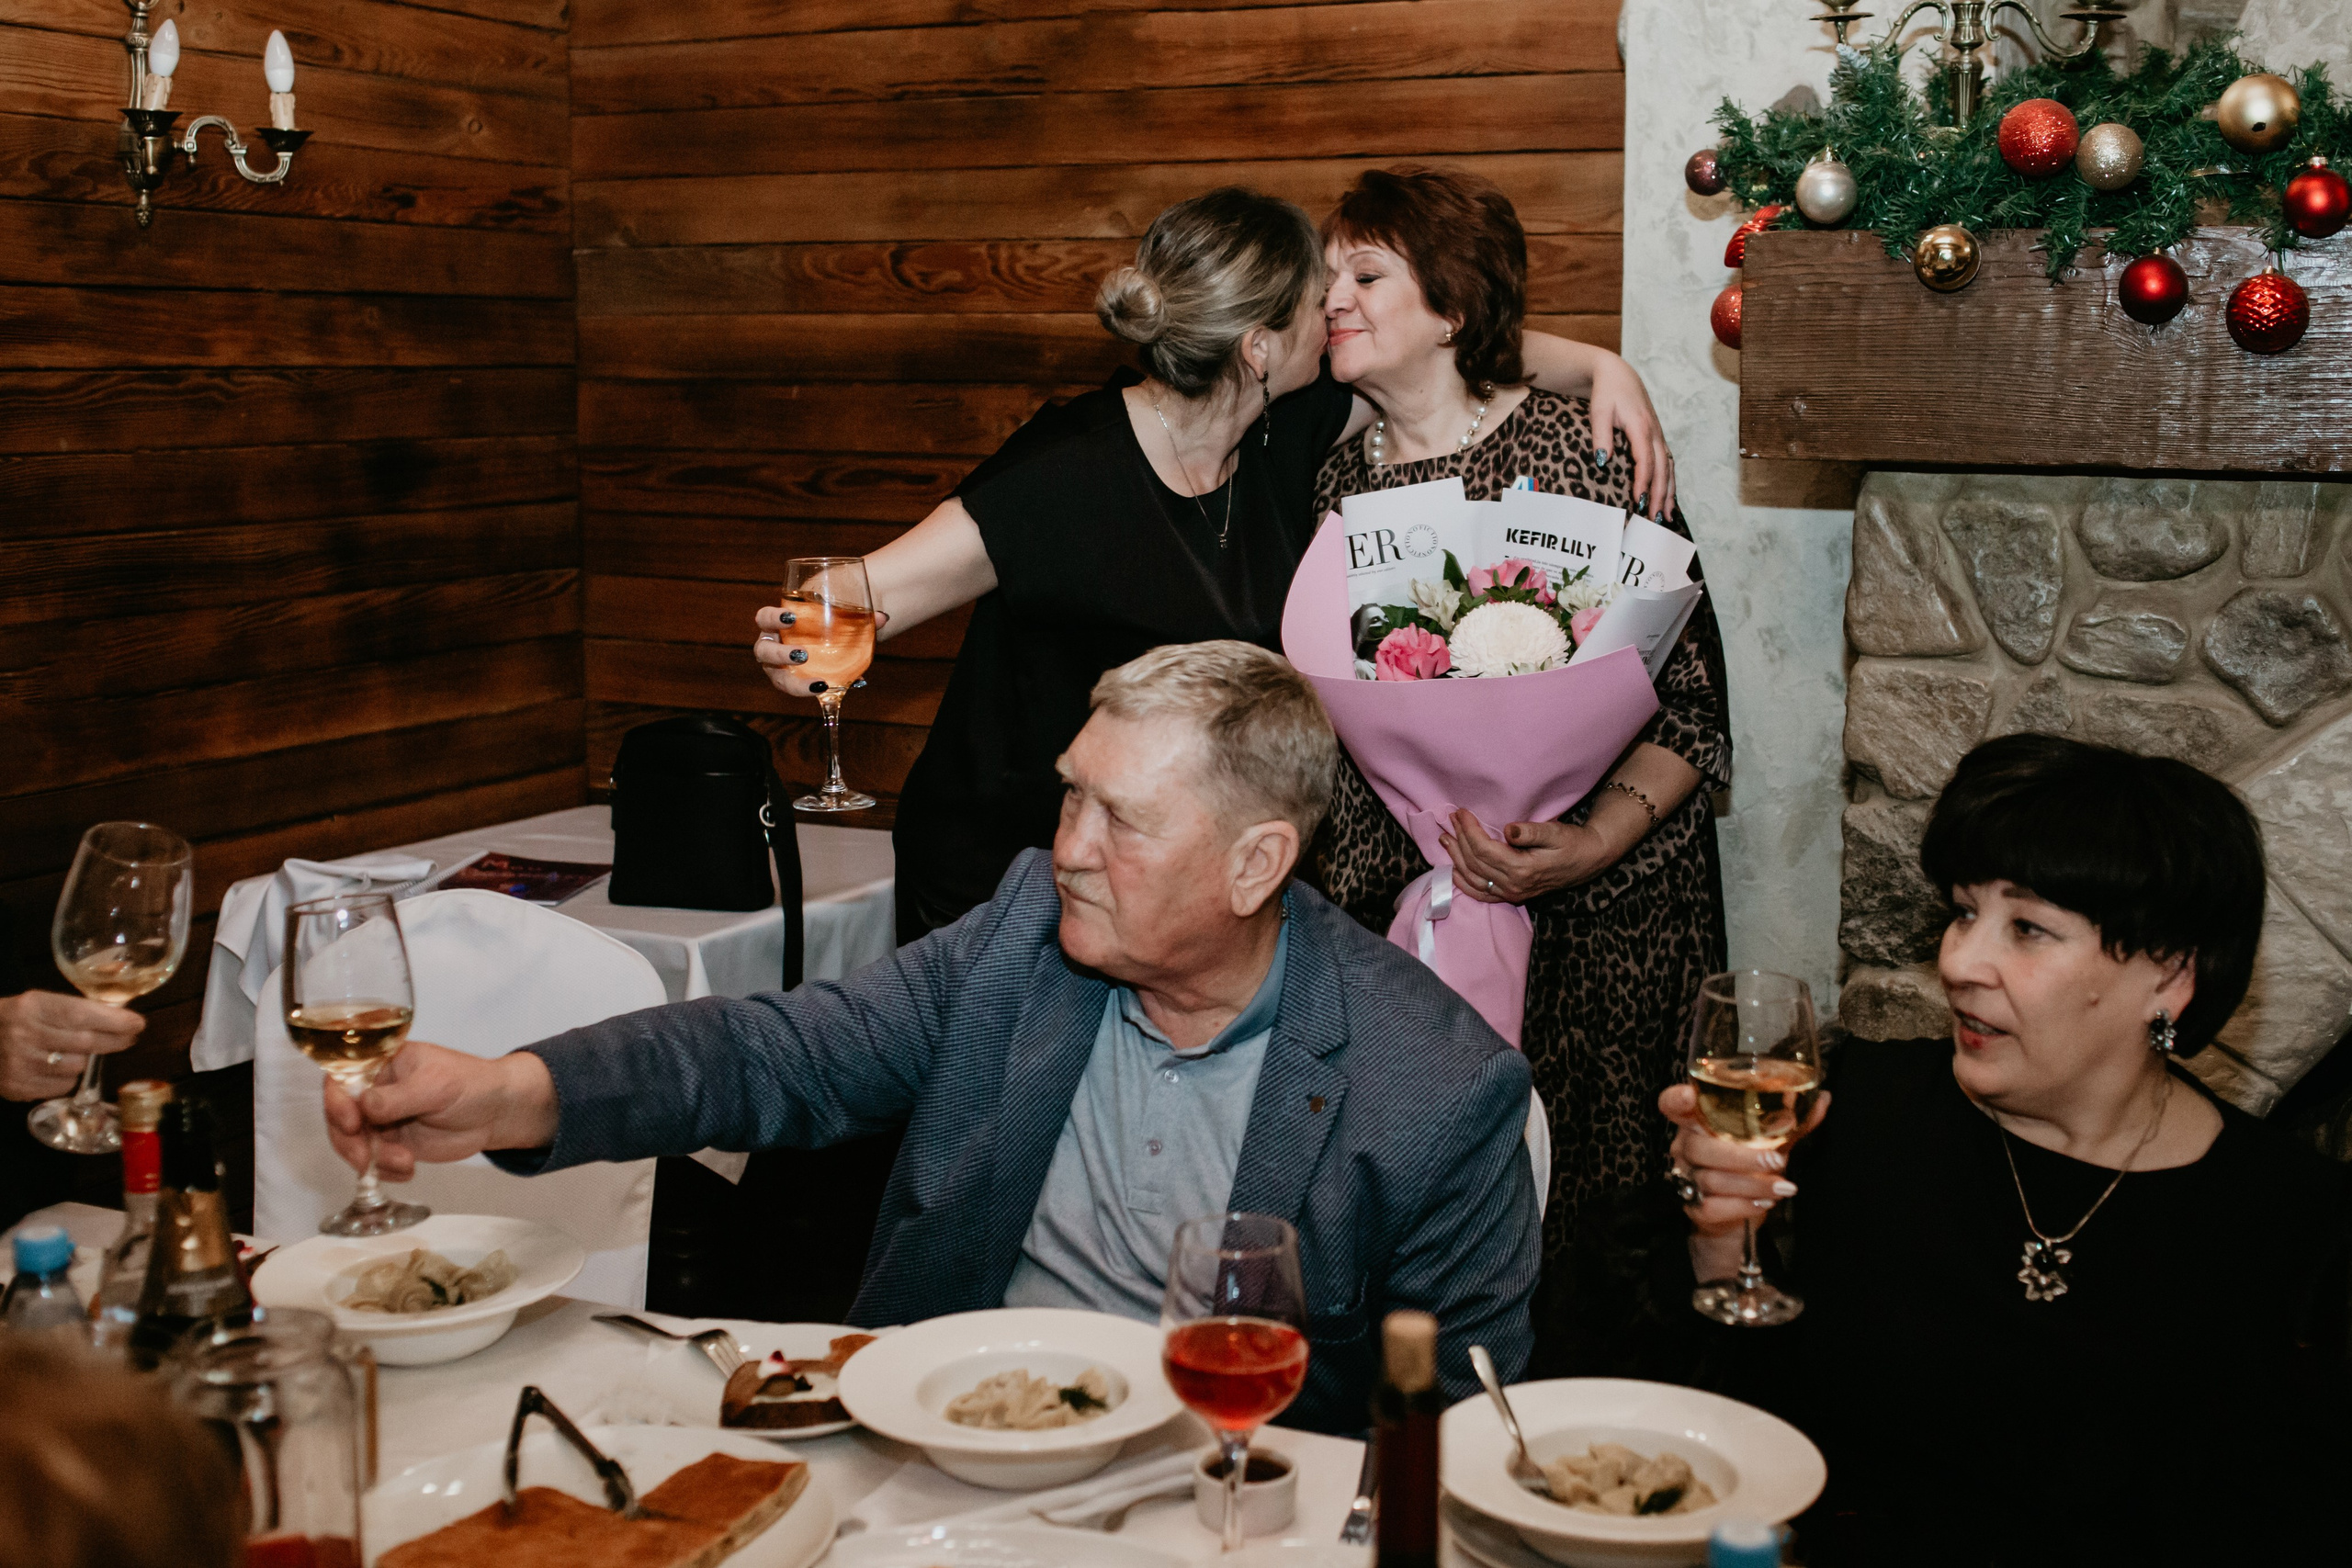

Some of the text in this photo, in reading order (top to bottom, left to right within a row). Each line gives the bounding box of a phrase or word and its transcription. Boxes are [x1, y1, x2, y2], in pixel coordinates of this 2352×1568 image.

[1345, 529, 1406, 570] ER
[1506, 527, 1597, 559] KEFIR LILY
